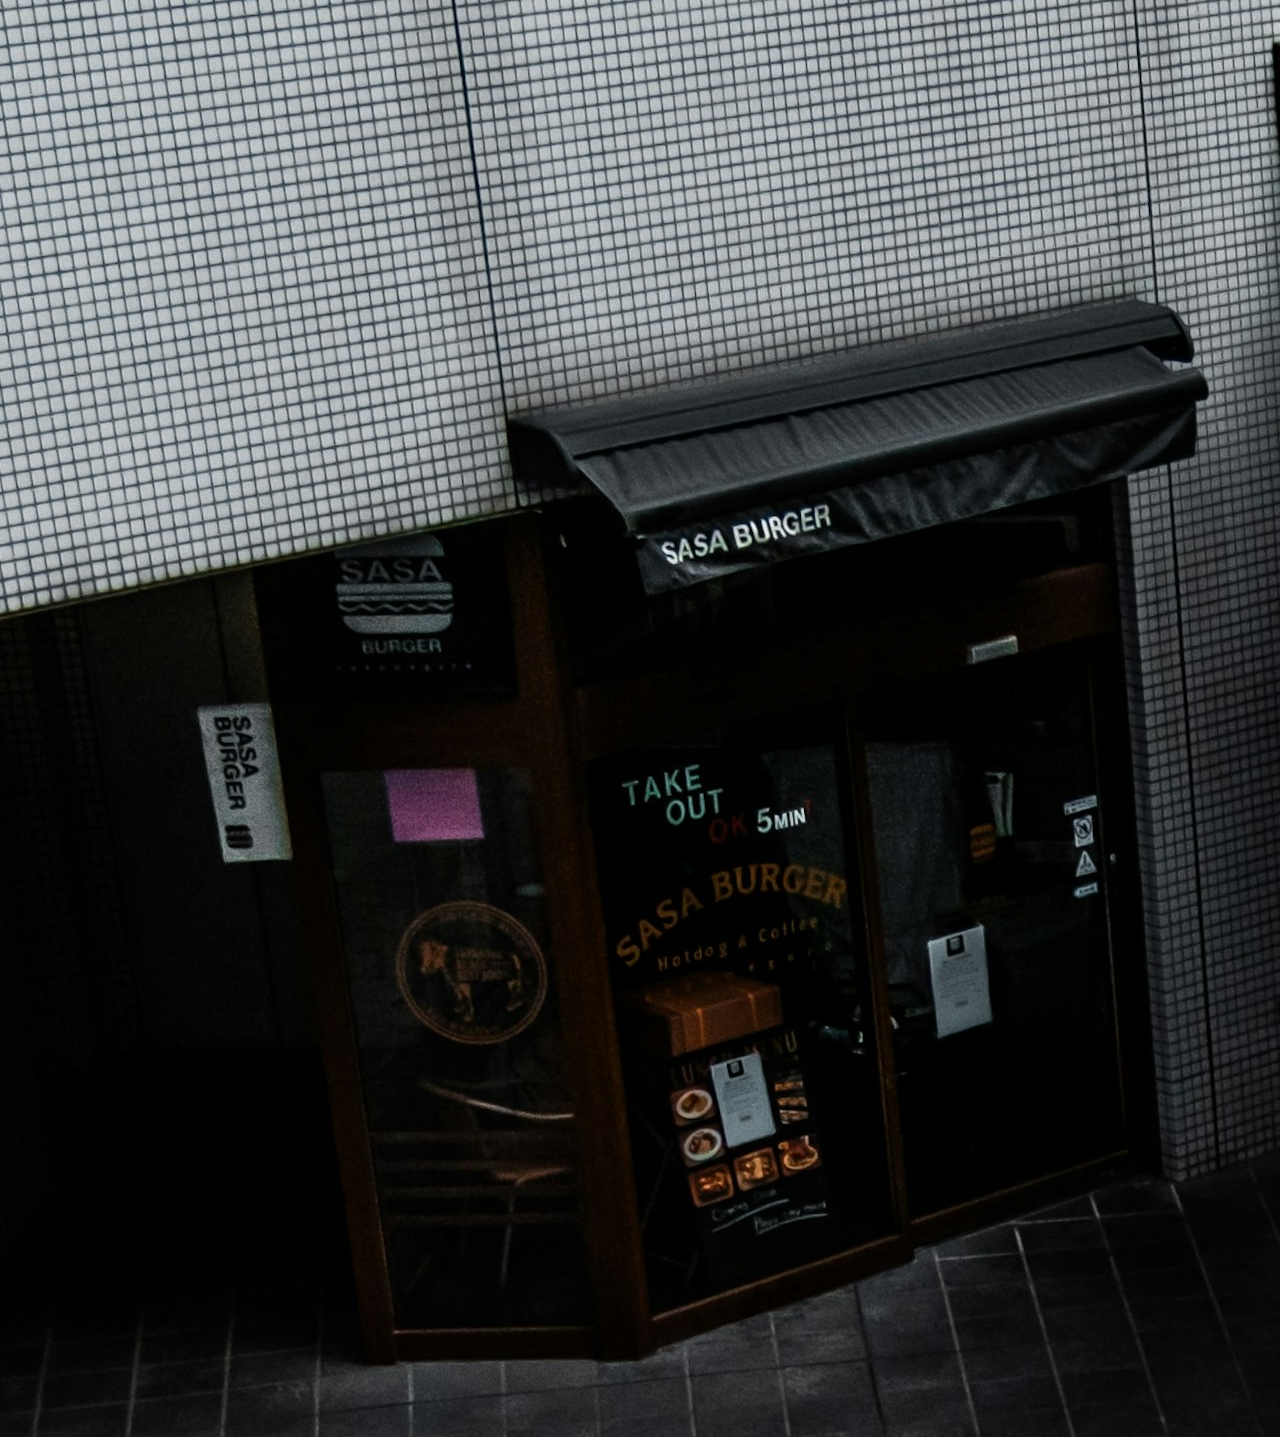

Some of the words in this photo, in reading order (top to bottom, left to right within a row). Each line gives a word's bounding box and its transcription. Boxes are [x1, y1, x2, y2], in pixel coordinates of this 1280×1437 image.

[661, 529, 729, 565] SASA
[732, 503, 832, 549] BURGER
[339, 559, 444, 583] SASA
[361, 638, 443, 655] BURGER
[214, 716, 246, 810] BURGER
[232, 716, 259, 778] SASA
[621, 764, 703, 806] TAKE
[665, 787, 724, 826] OUT
[615, 885, 705, 968] SASA
[709, 861, 848, 910] BURGER
[656, 941, 729, 972] Hotdog
